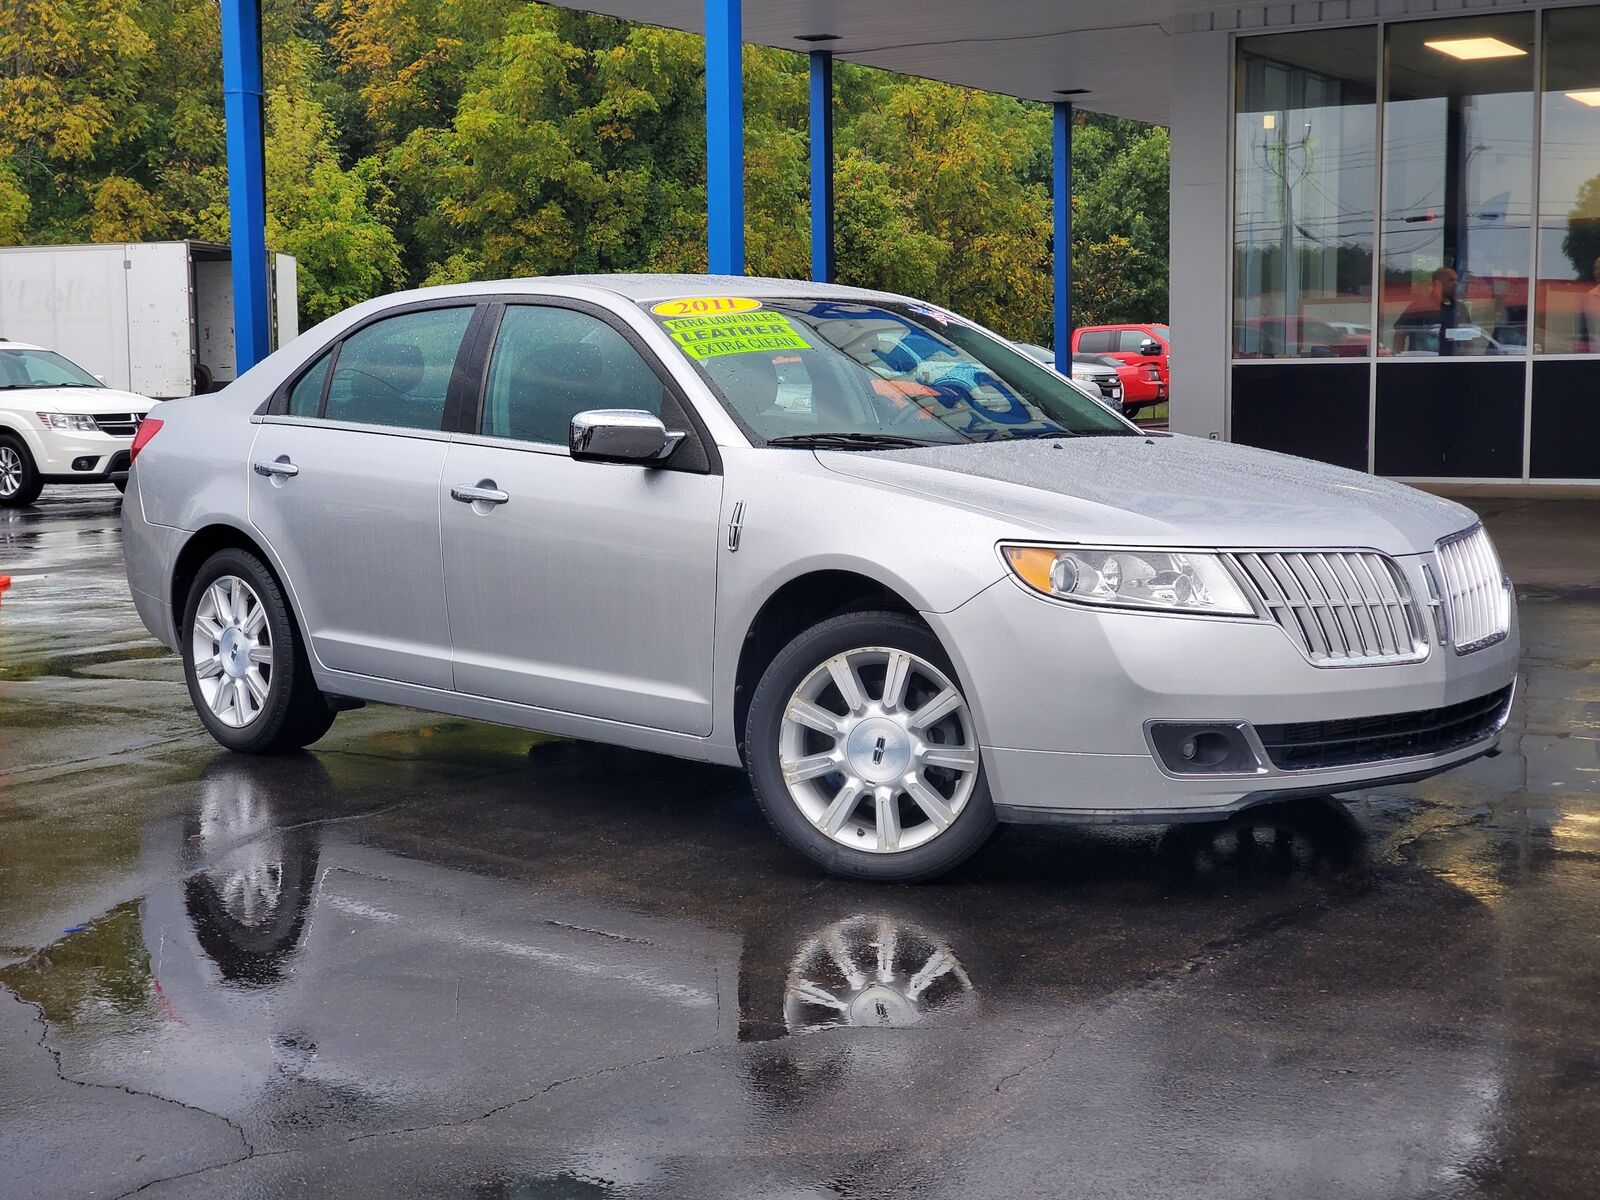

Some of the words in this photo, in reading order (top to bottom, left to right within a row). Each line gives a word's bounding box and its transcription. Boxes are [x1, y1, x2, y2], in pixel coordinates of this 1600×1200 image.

[675, 298, 736, 314] 2011
[708, 315, 737, 325] LOW
[738, 313, 781, 323] MILES
[681, 325, 786, 342] LEATHER
[694, 341, 748, 356] EXTRA
[748, 336, 798, 349] CLEAN
